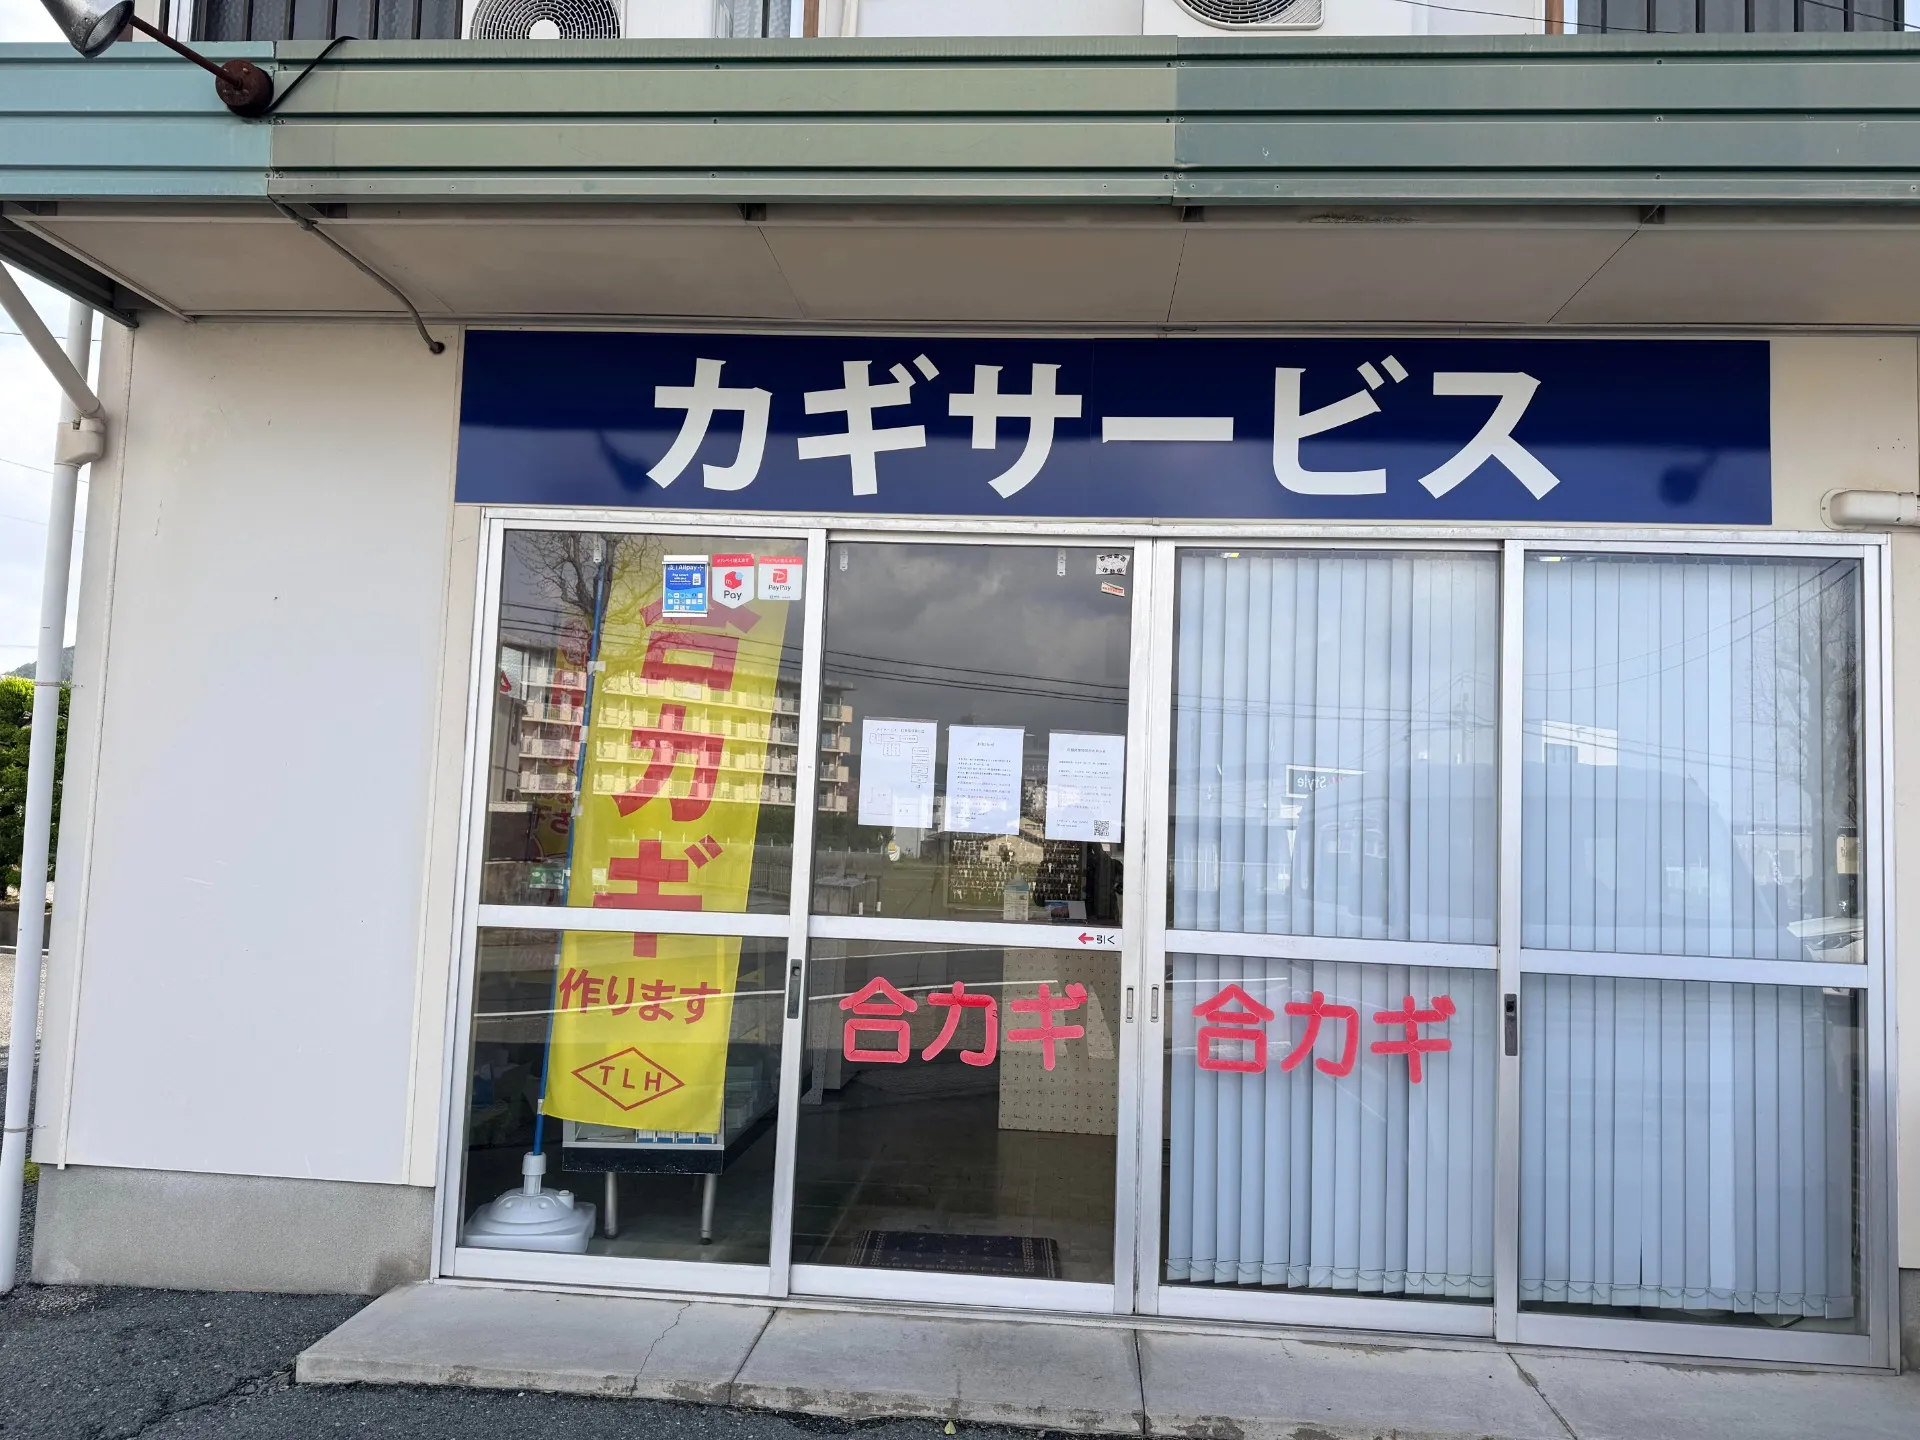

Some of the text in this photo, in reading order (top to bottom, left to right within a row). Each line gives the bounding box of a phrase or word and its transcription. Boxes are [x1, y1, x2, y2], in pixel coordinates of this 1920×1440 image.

[645, 353, 1561, 501] カギサービス
[723, 590, 742, 600] Pay
[1096, 934, 1115, 944] 引く
[559, 967, 722, 1024] 作ります
[839, 976, 1088, 1072] 合カギ
[1191, 983, 1457, 1085] 合カギ
